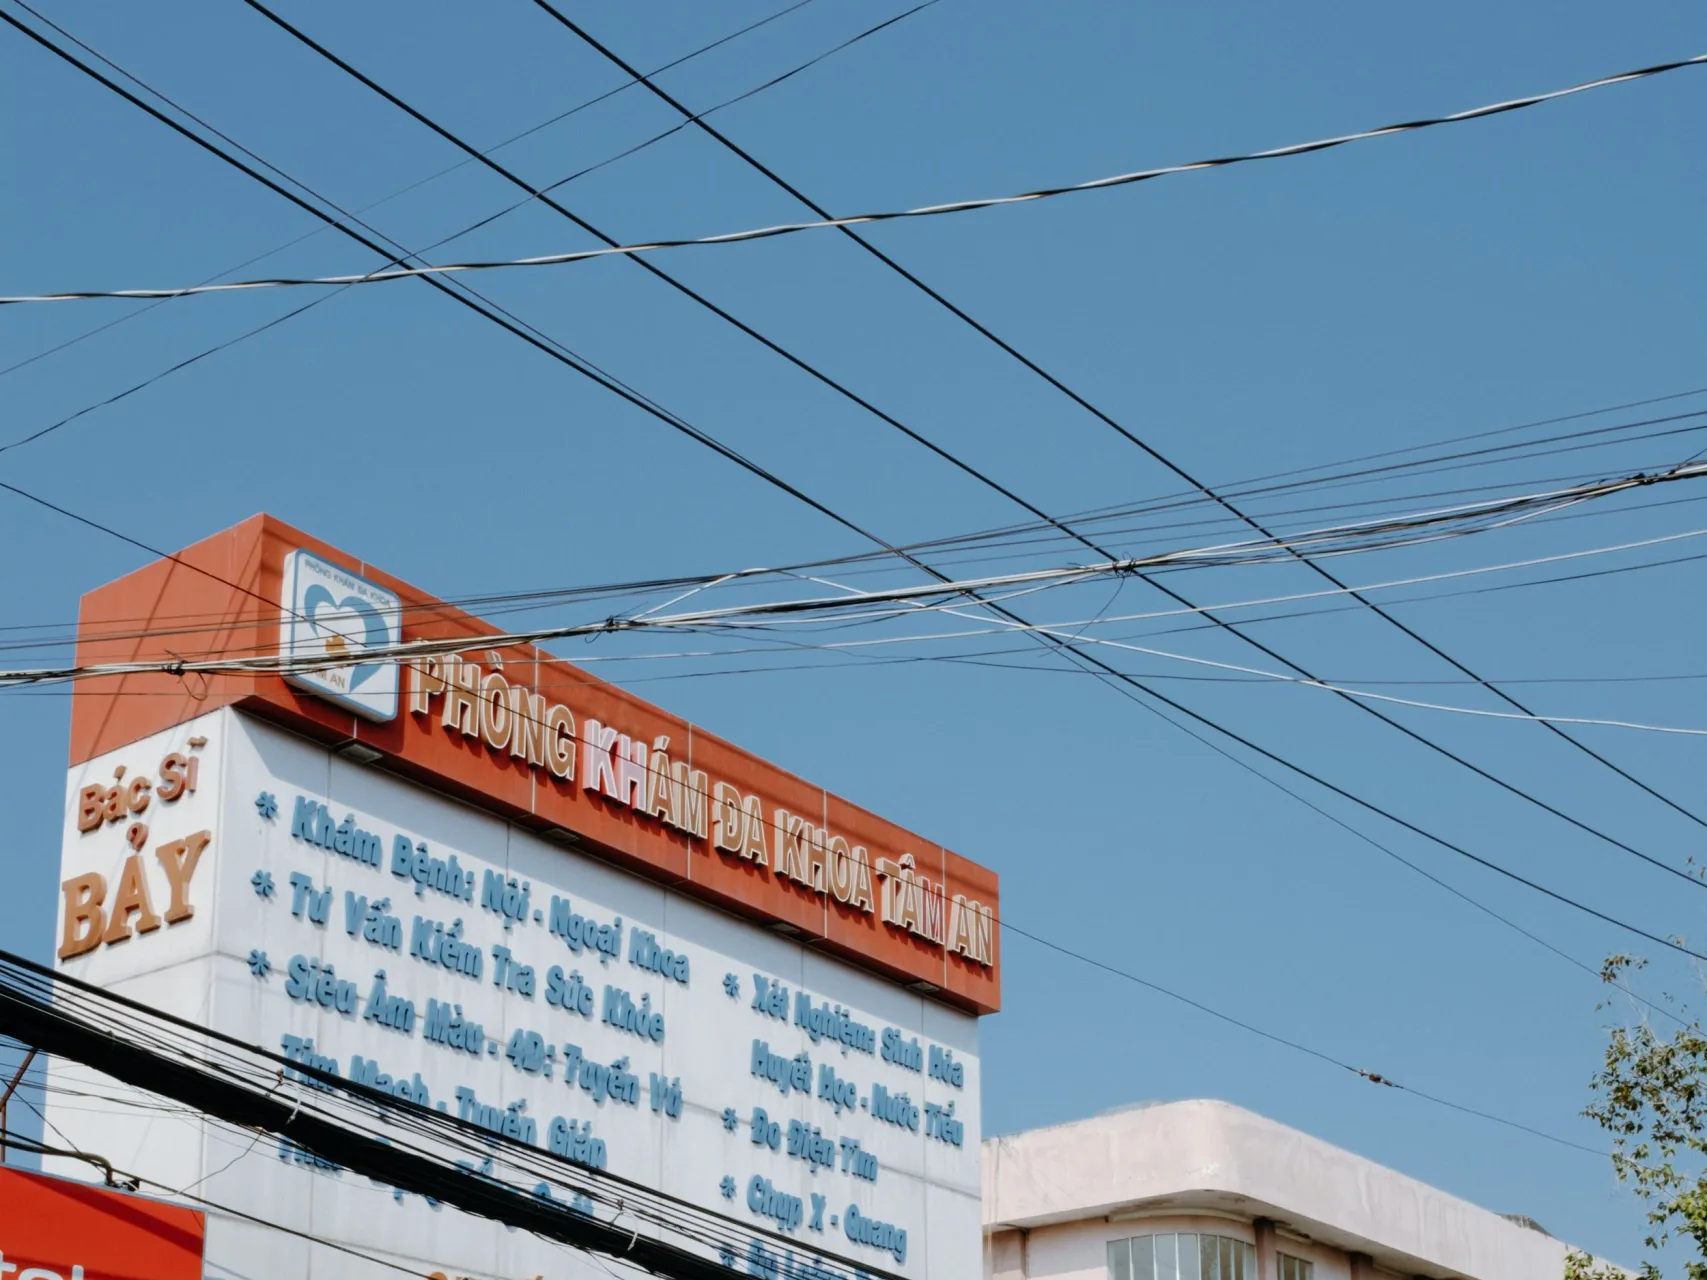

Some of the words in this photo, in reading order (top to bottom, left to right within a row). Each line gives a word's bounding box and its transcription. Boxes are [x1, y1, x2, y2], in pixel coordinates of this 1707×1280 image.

[78, 765, 152, 833] Bác
[156, 735, 209, 801] Sĩ
[409, 649, 577, 782] PHÒNG
[583, 716, 709, 840] KHÁM
[713, 781, 769, 868] ĐA
[774, 807, 876, 913] KHOA
[876, 852, 946, 947] TÂM
[946, 892, 994, 967] AN
[57, 822, 211, 960] BẢY
[290, 871, 333, 926] Tư
[344, 890, 403, 951] Vấn
[410, 915, 484, 980] Kiểm
[492, 944, 536, 998] Tra
[545, 964, 595, 1018] Sức
[291, 795, 382, 868] Khám
[391, 834, 475, 900] Bệnh:
[481, 869, 532, 932] Nội
[548, 894, 623, 964] Ngoại
[628, 926, 690, 984] Khoa
[280, 1033, 340, 1091] Tim
[285, 955, 359, 1015] Siêu
[363, 969, 415, 1032] Âm
[423, 997, 485, 1056] Màu
[506, 1028, 557, 1078] 4D:
[562, 1043, 640, 1106] Tuyến
[649, 1071, 683, 1119] Vú
[751, 973, 790, 1021] Xét
[880, 1027, 923, 1073] Sinh
[928, 1044, 965, 1089] Hóa
[751, 1038, 813, 1094] Huyết
[817, 1063, 857, 1115] Học
[871, 1083, 920, 1131] Nước
[751, 1106, 782, 1151] Đo
[787, 1119, 836, 1174] Điện
[839, 1136, 879, 1181] Tim
[746, 1174, 804, 1231] Chụp
[808, 1192, 828, 1231] X
[844, 1203, 907, 1264] Quang
